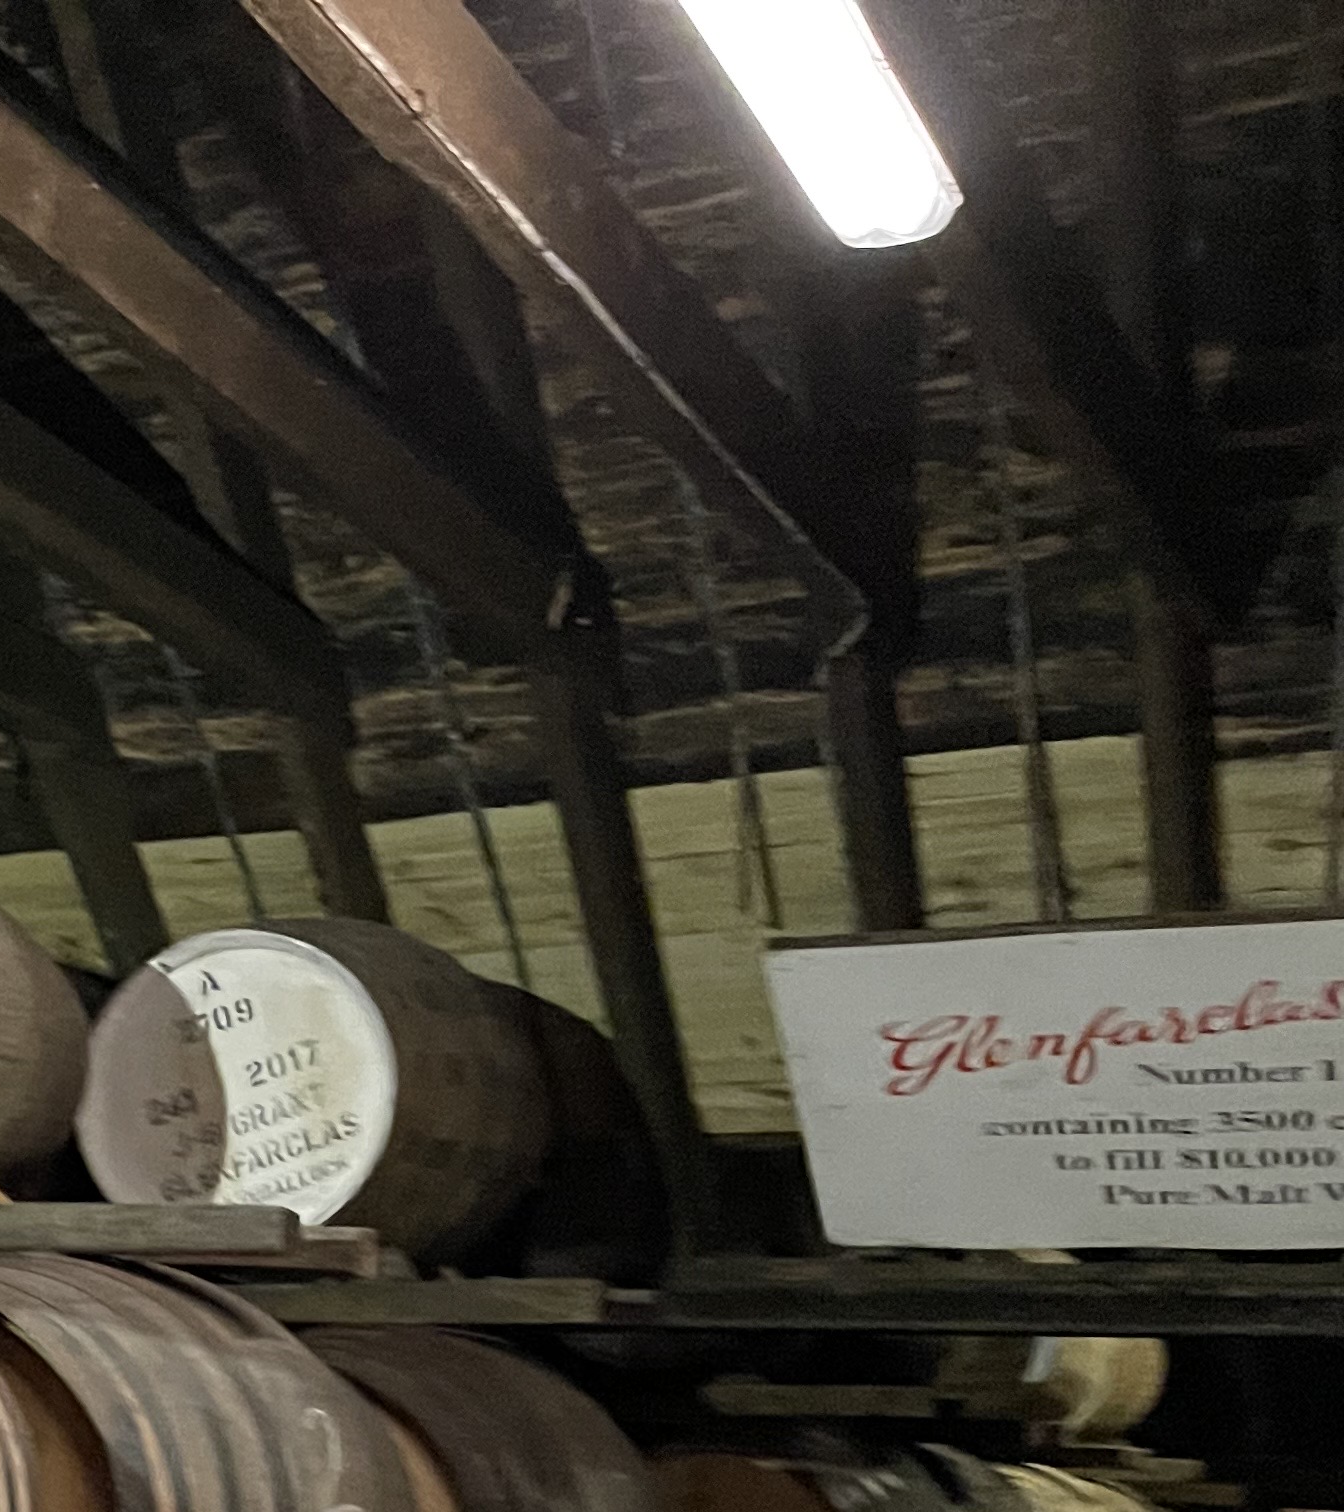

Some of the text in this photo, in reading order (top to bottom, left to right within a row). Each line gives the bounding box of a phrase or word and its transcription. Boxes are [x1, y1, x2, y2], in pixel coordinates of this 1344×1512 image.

[200, 970, 221, 996] A
[881, 979, 1344, 1096] Glenfarclas
[245, 1039, 320, 1087] 2017
[1137, 1061, 1311, 1085] Number
[980, 1112, 1199, 1136] containing
[1208, 1110, 1314, 1132] 3500
[1054, 1153, 1094, 1171] to
[1107, 1148, 1162, 1171] fill
[1099, 1183, 1200, 1205] Pure
[1204, 1183, 1310, 1205] Malt
